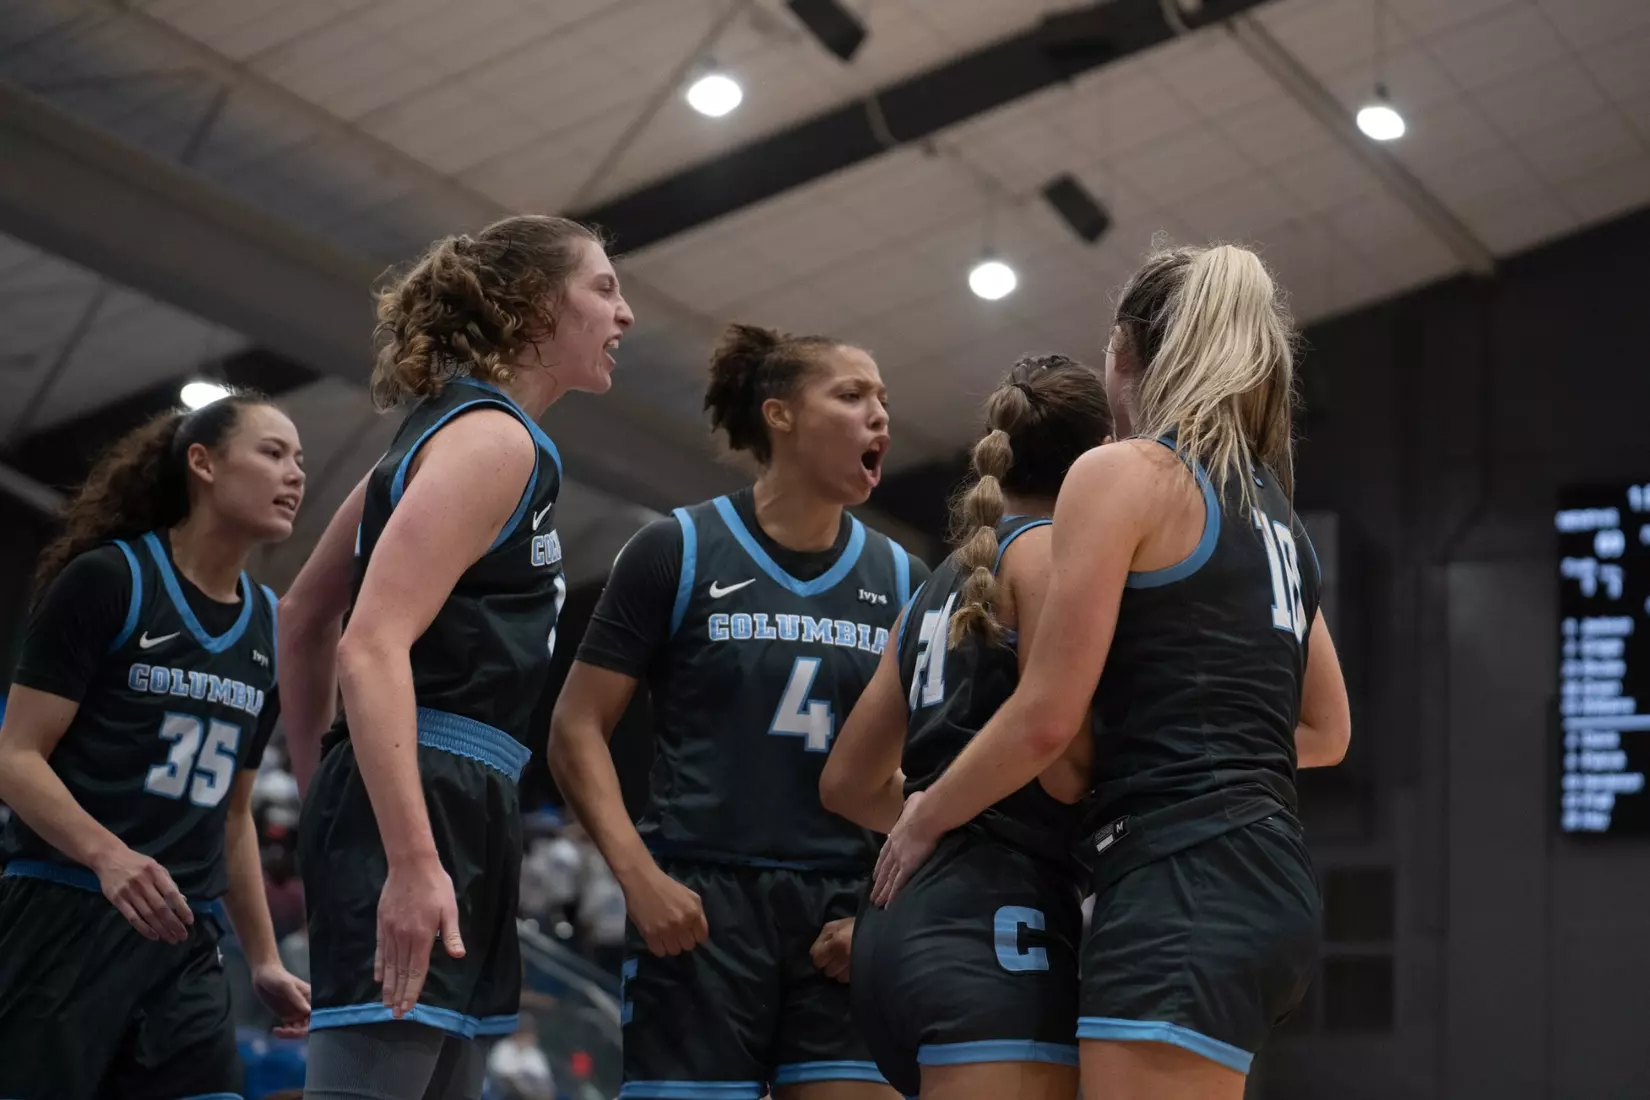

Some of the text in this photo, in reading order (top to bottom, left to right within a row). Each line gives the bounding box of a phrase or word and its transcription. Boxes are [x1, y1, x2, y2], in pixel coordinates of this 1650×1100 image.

[767, 656, 835, 753] 4
[143, 711, 242, 809] 35
[993, 905, 1050, 972] C
